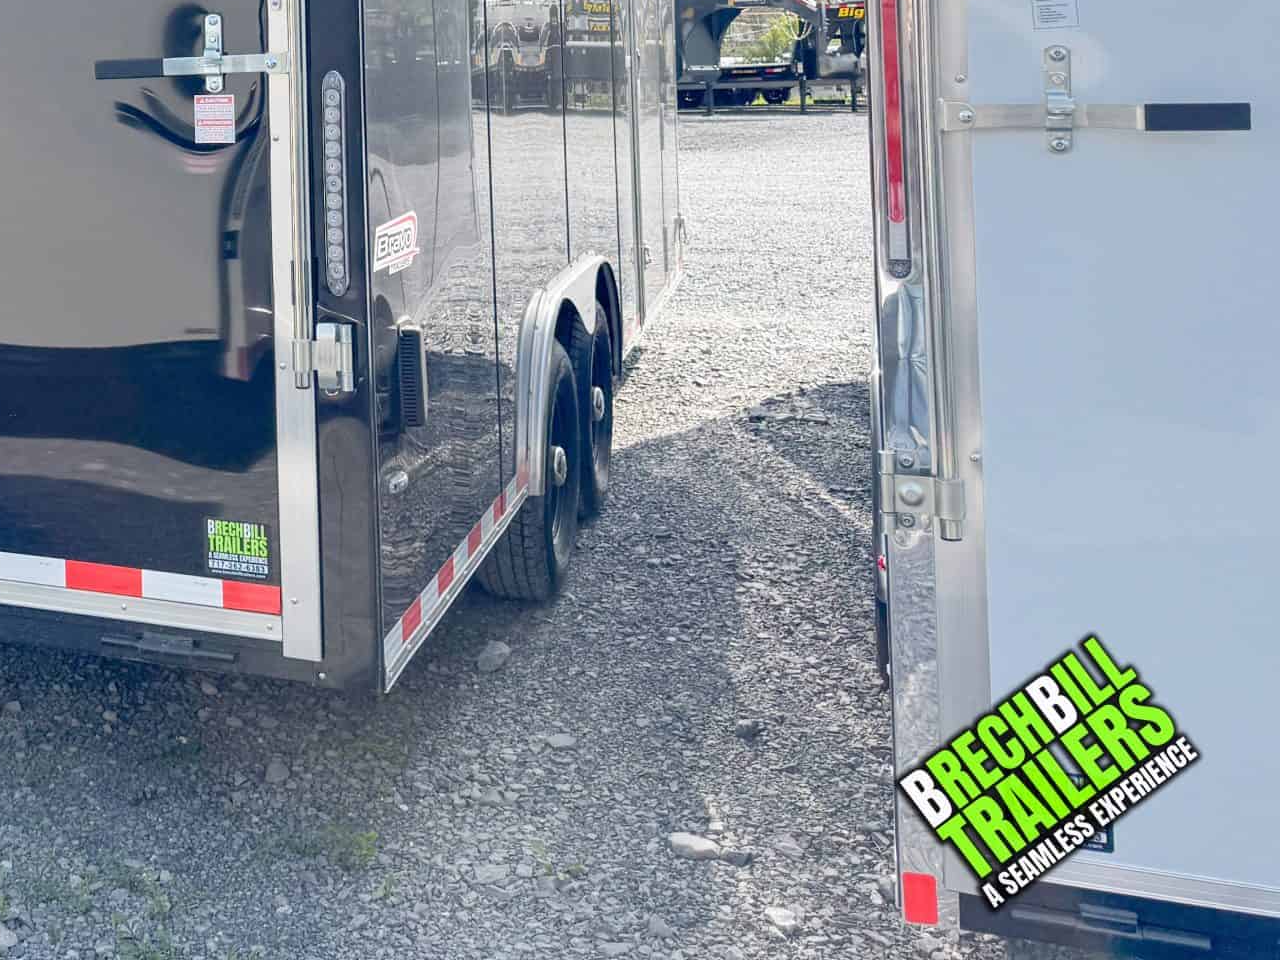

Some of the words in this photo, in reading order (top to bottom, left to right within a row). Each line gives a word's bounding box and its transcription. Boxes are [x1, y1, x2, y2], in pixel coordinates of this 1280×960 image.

[838, 7, 865, 19] Big
[376, 227, 412, 261] Bravo
[207, 519, 267, 540] BRECHBILL
[208, 535, 268, 557] TRAILERS
